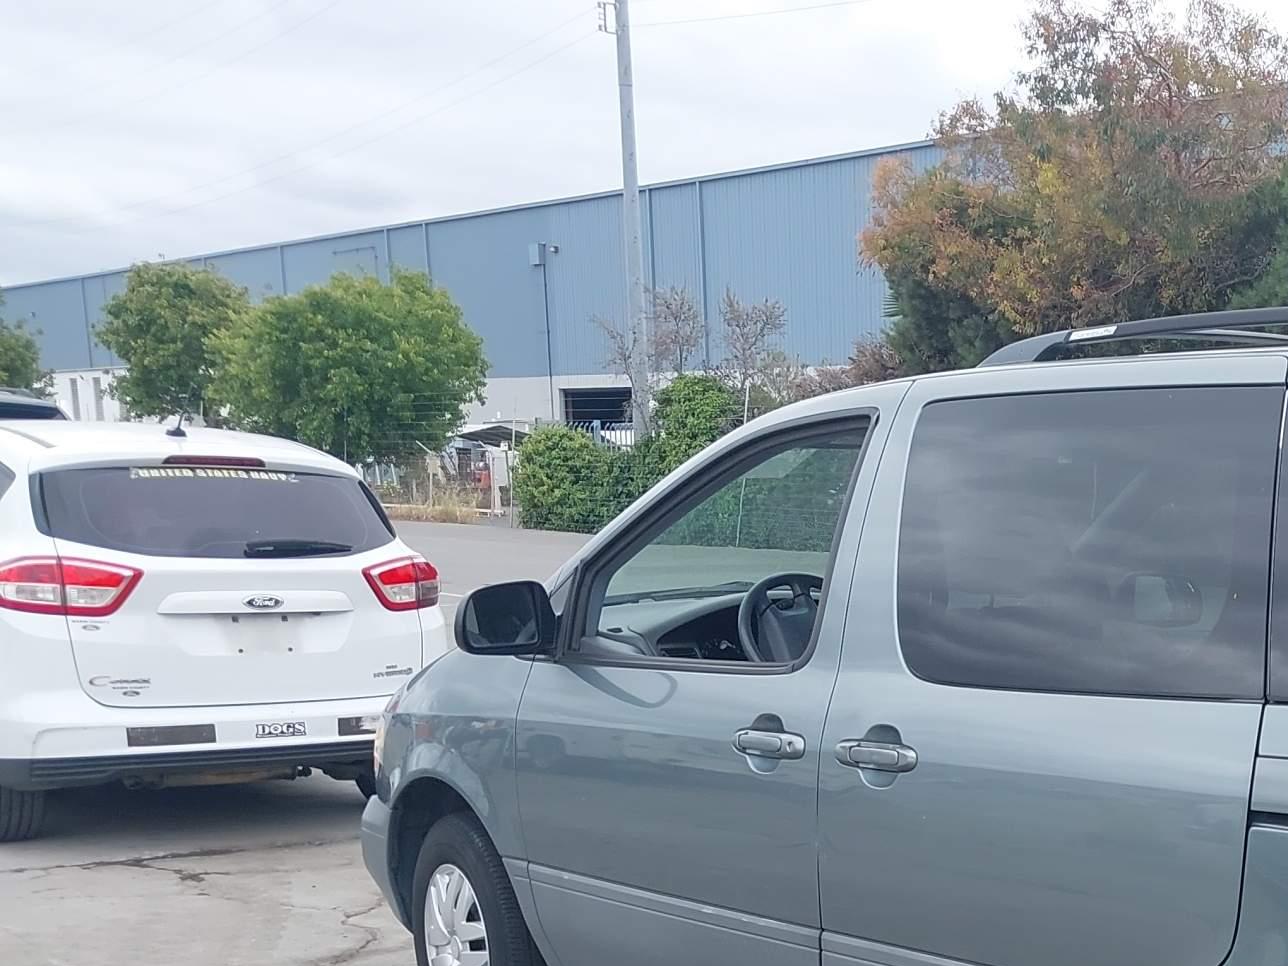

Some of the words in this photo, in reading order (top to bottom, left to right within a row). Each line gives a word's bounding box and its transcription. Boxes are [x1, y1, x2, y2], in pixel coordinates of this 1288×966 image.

[138, 468, 194, 478] UNITED
[197, 469, 249, 479] STATES
[256, 722, 306, 735] DOGS
